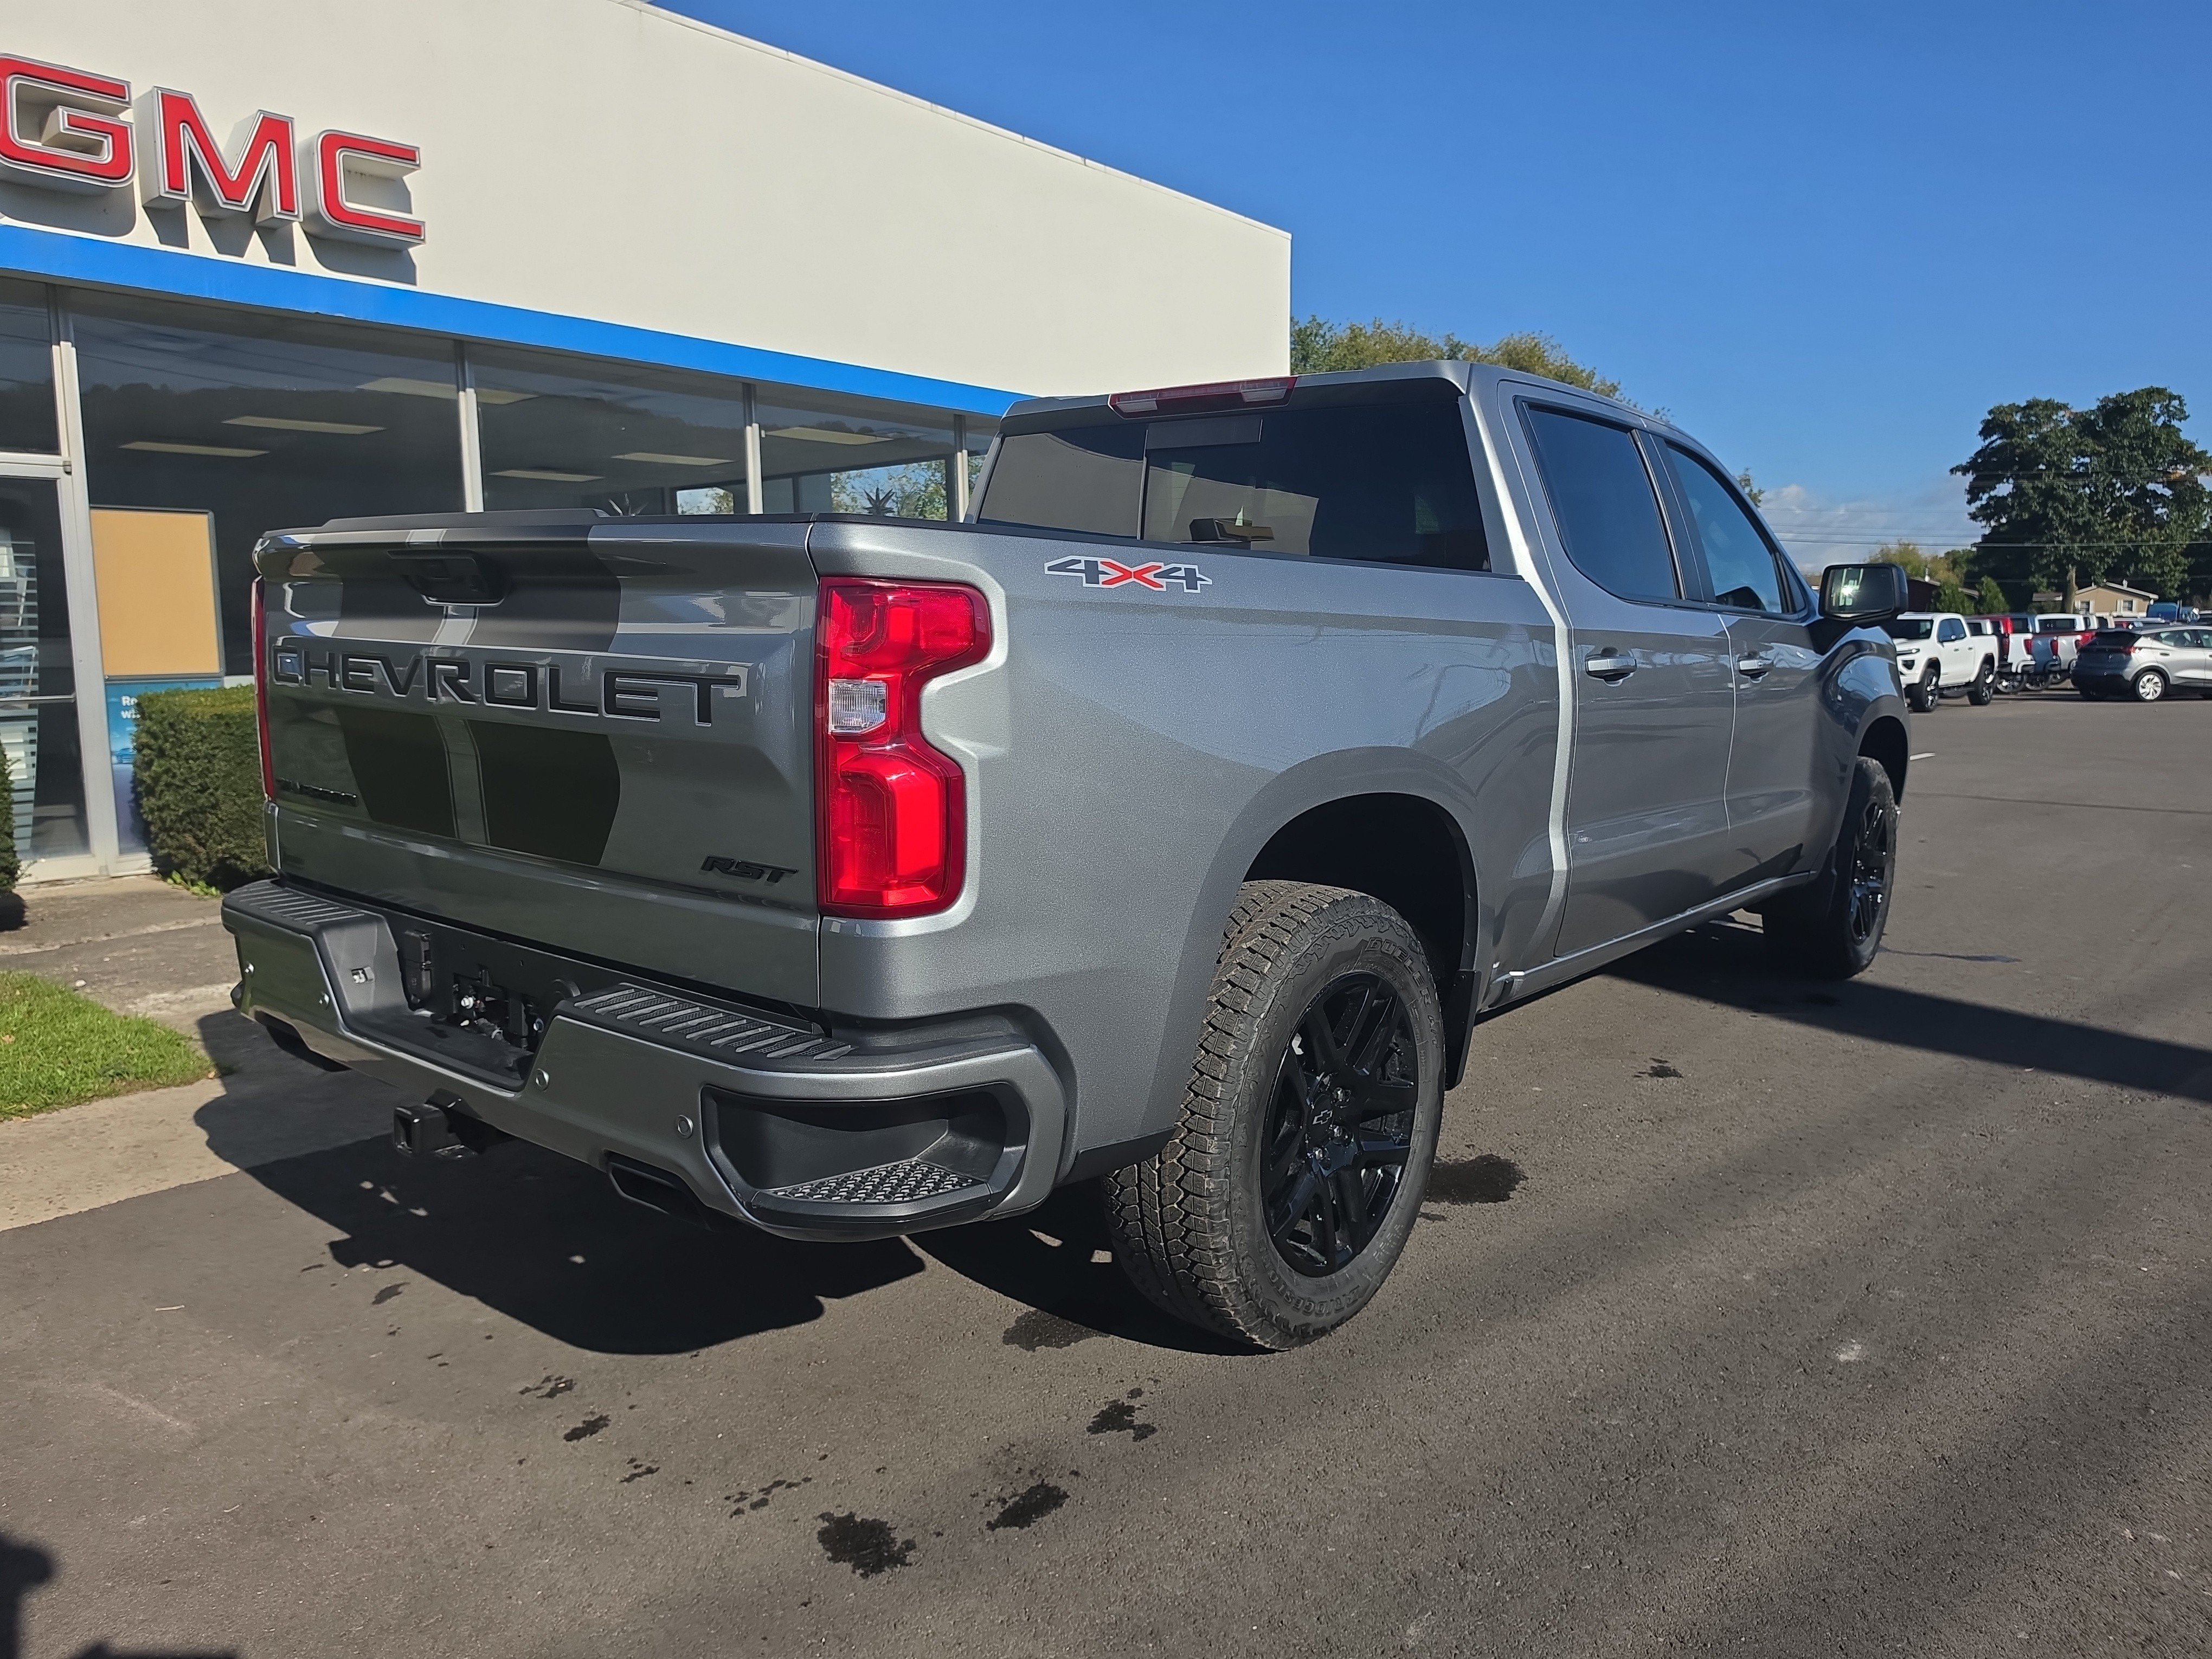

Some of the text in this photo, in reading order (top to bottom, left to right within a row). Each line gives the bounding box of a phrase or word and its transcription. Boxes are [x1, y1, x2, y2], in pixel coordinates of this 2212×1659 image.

[0, 53, 426, 248] GMC
[273, 645, 744, 728] CHEVROLET
[700, 855, 799, 884] RST
[1364, 936, 1432, 1007] DUELER
[1256, 1236, 1362, 1317] BRIDGESTONE
